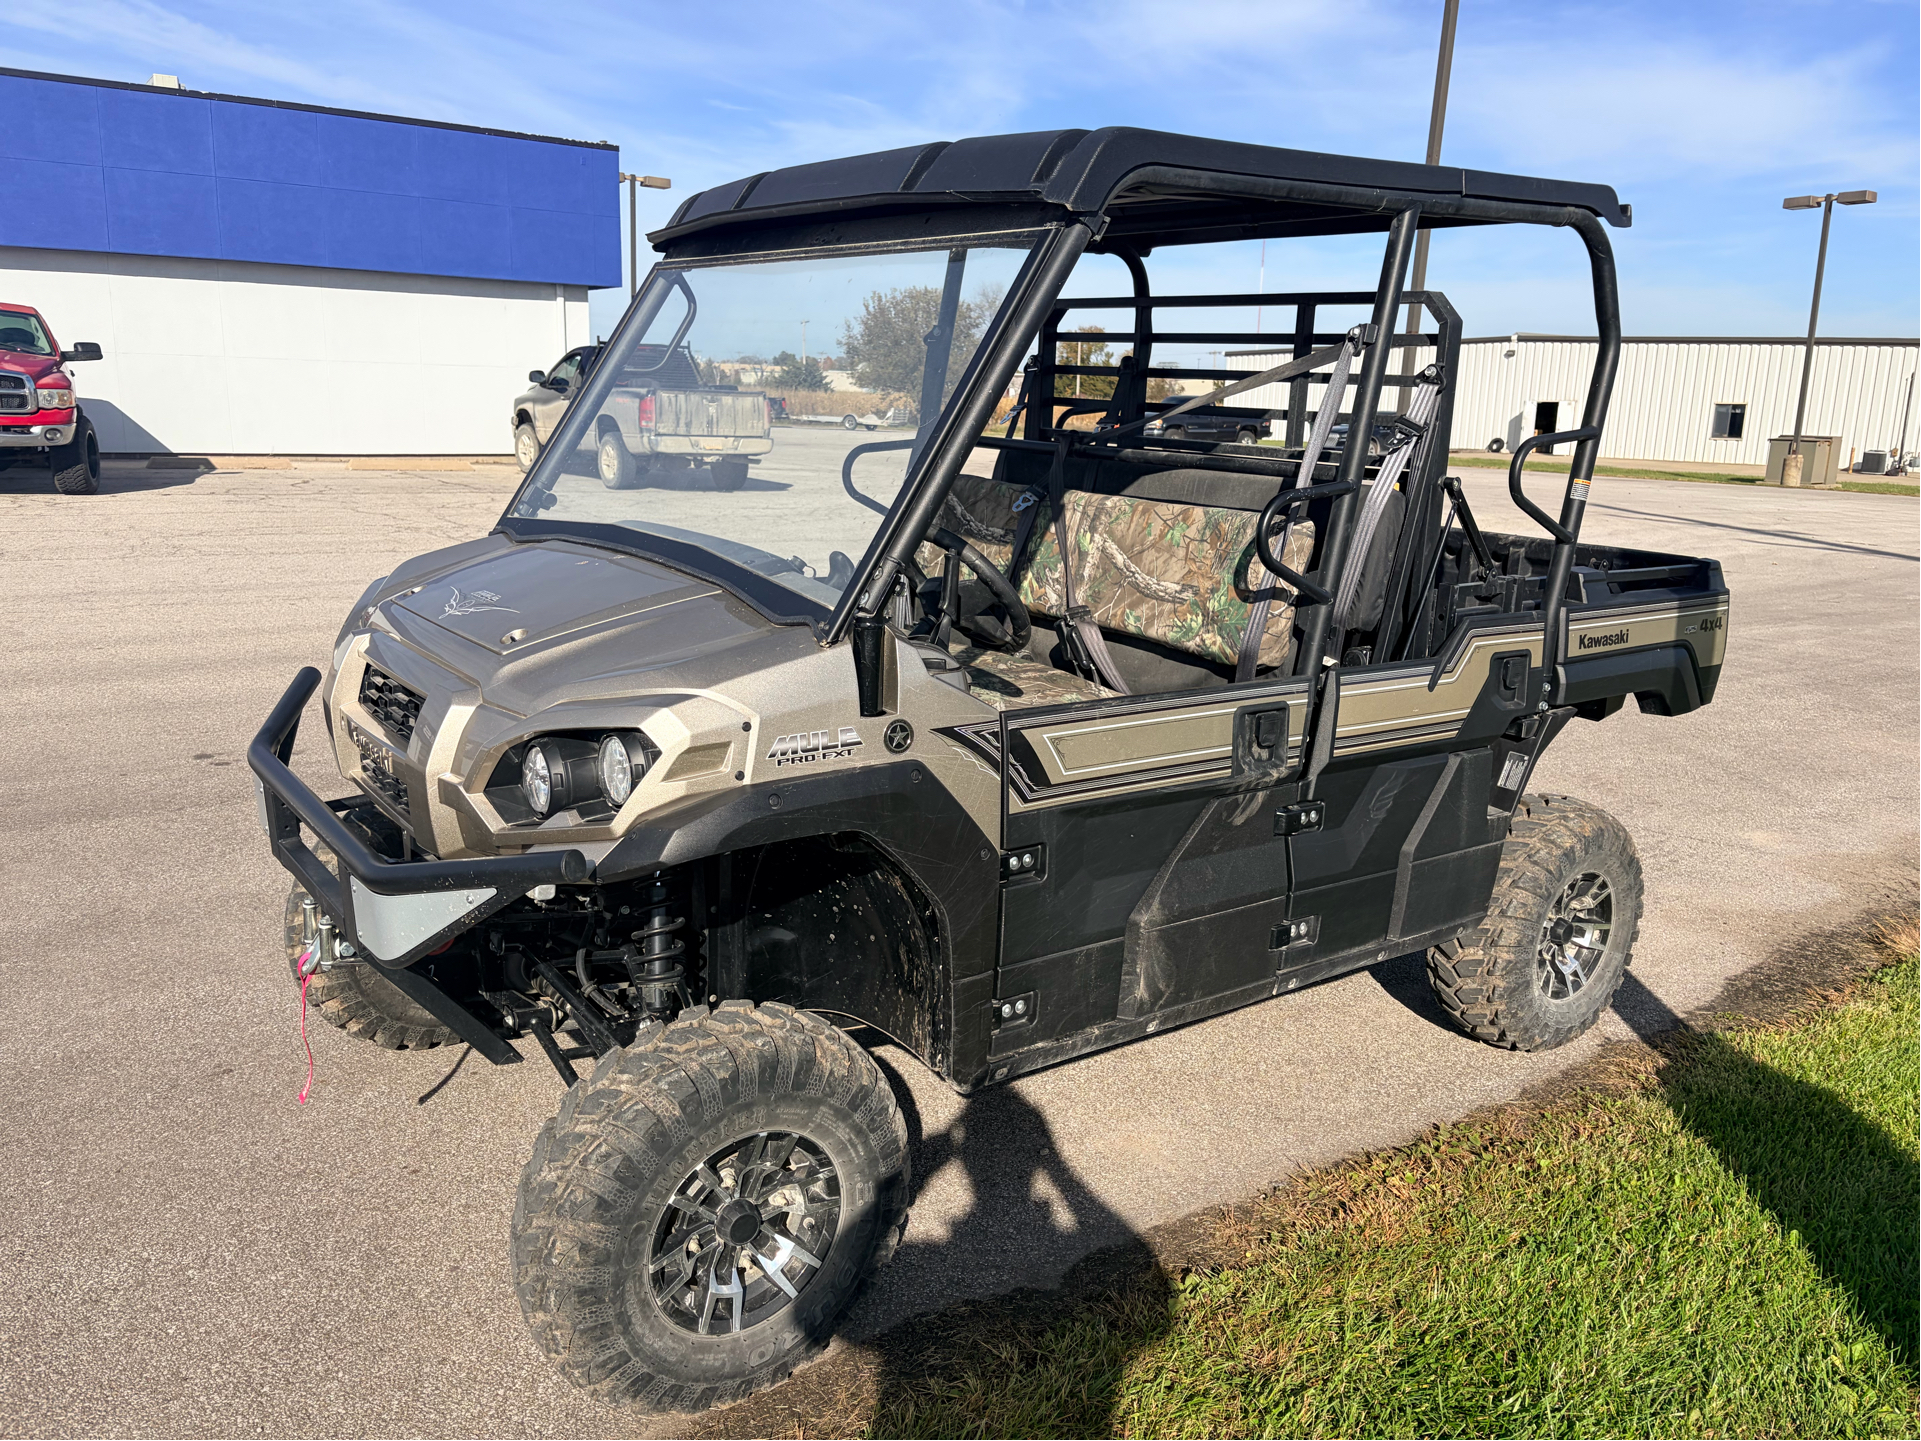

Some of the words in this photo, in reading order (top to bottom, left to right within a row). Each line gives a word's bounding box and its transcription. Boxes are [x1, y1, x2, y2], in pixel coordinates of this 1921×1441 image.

[1700, 616, 1723, 632] 4x4
[1578, 629, 1629, 650] Kawasaki
[766, 727, 864, 759] MULE
[776, 747, 855, 767] PRO-FXT
